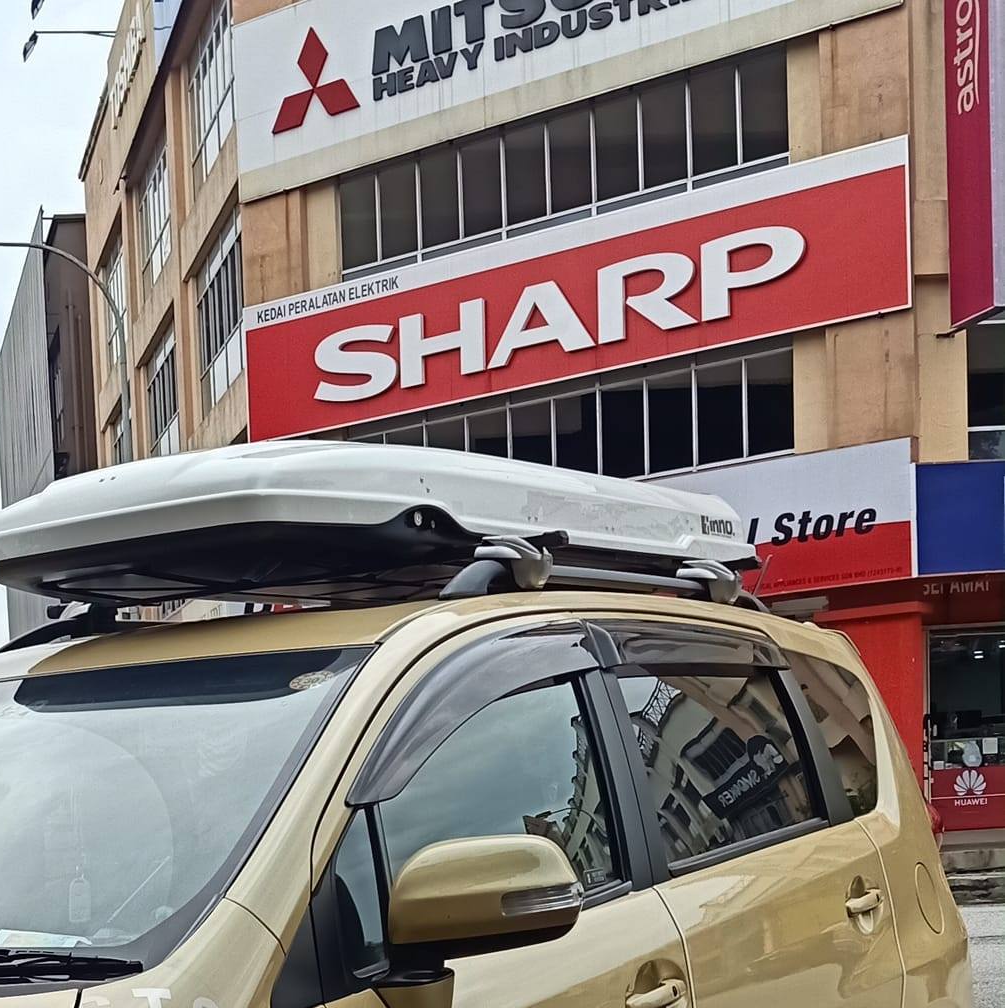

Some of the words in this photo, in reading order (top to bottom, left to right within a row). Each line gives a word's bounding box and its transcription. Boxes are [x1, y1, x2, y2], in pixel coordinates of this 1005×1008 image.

[372, 0, 593, 75] MITS
[953, 0, 974, 115] astro
[372, 42, 484, 101] HEAVY
[256, 305, 286, 324] KEDAI
[288, 290, 346, 315] PERALATAN
[348, 275, 399, 300] ELEKTRIK
[313, 225, 807, 402] SHARP
[771, 508, 877, 546] Store
[954, 797, 988, 806] HUAWEI
